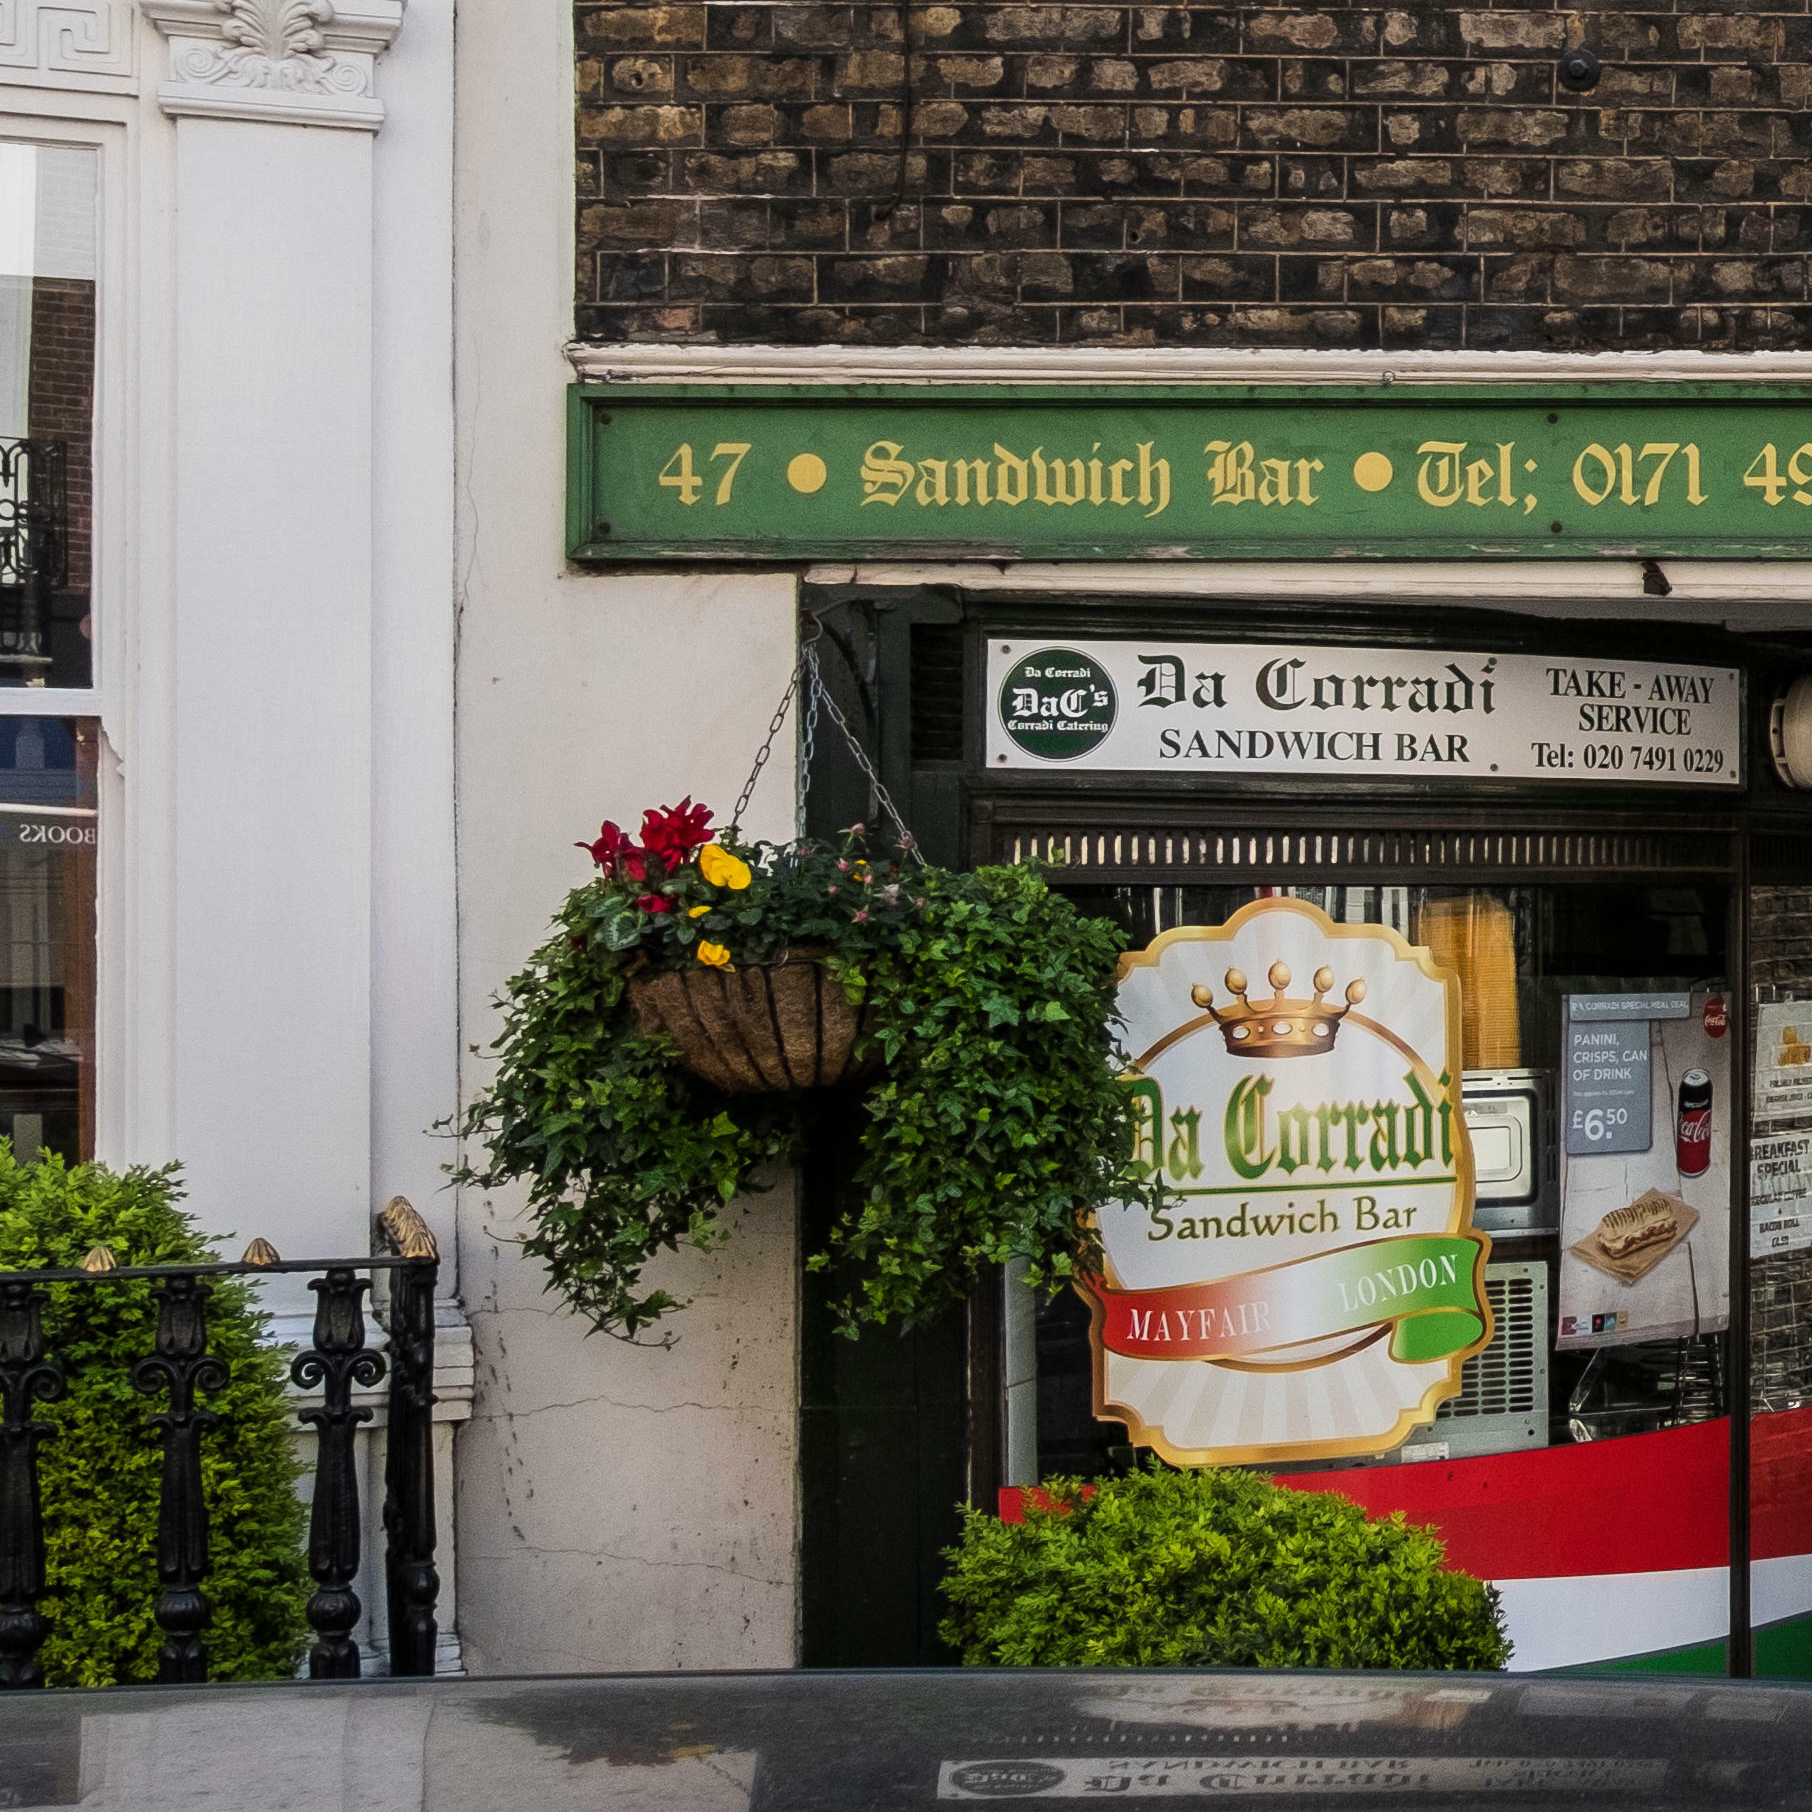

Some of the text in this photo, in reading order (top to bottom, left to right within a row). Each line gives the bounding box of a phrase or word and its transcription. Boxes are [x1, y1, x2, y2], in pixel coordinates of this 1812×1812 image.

[657, 441, 753, 507] 47
[860, 440, 1172, 519] Sandwich
[1205, 439, 1326, 508] Bar
[1571, 441, 1709, 507] 0171
[1024, 666, 1091, 678] Da Corradi
[1136, 654, 1498, 716] Da Corradi
[1546, 667, 1629, 699] TAKE
[1647, 673, 1715, 706] AWAY
[1011, 683, 1109, 718] DaC's
[1007, 719, 1109, 733] Corradi Catering
[1577, 701, 1692, 737] SERVICE
[1159, 728, 1471, 764] SANDWICH BAR
[1531, 742, 1725, 774] Tel: 020 7491 0229
[1573, 1034, 1620, 1047] PANINI,
[1573, 1050, 1648, 1065] CRISPS, CAN
[1572, 1068, 1633, 1081] OF DRINK
[1122, 1067, 1458, 1183] Da Corradi
[1147, 1192, 1418, 1243] Sandwich Bar
[1126, 1253, 1461, 1343] MAYFAIR LONDON
